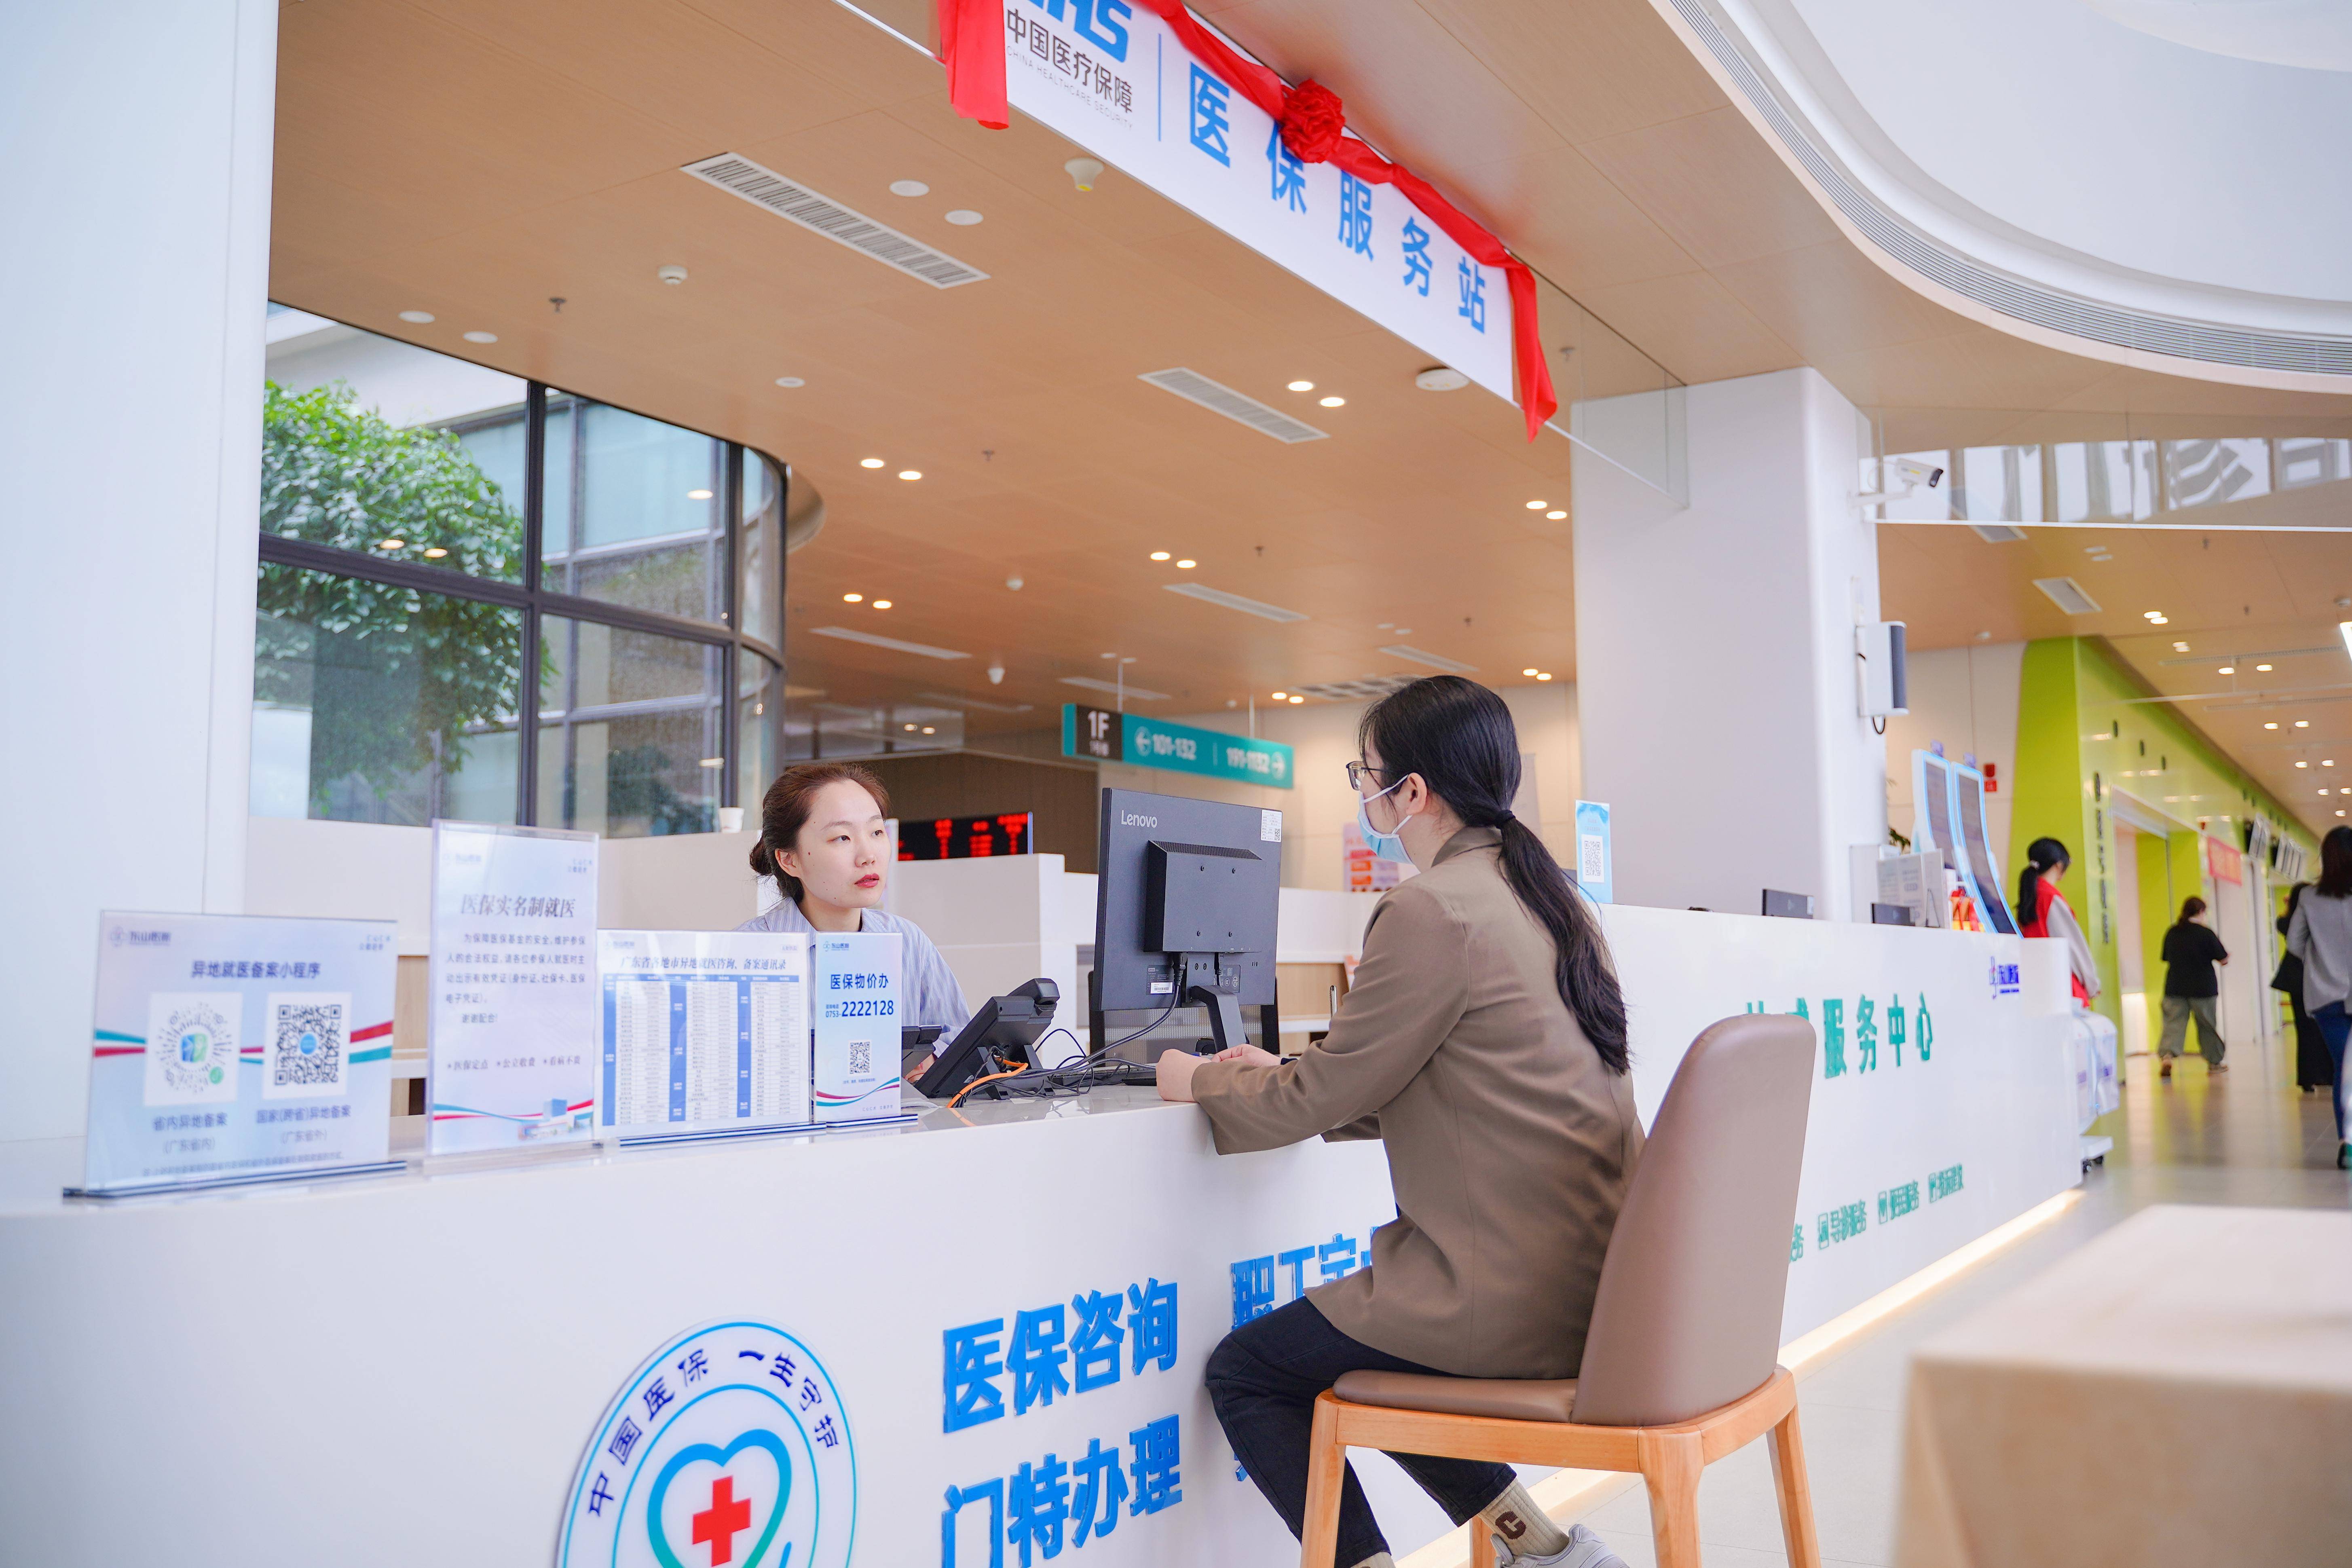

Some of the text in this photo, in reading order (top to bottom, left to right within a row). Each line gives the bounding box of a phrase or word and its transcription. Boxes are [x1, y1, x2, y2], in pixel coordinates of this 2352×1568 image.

[1007, 8, 1132, 113] 中国医疗保障
[1190, 61, 1485, 335] 医保服务站
[1088, 710, 1110, 739] 1F
[1121, 810, 1158, 828] Lenovo
[461, 893, 576, 918] 医保实名制就医
[191, 960, 321, 978] 异地就医备案小程序
[830, 973, 888, 989] 医保物价办
[1747, 991, 1933, 1079] 服务中心
[943, 1277, 1178, 1434] 医保咨询
[588, 1348, 839, 1517] 中国医保 一生守护
[942, 1414, 1183, 1568] 门特办理
[1496, 1511, 1526, 1540] C
